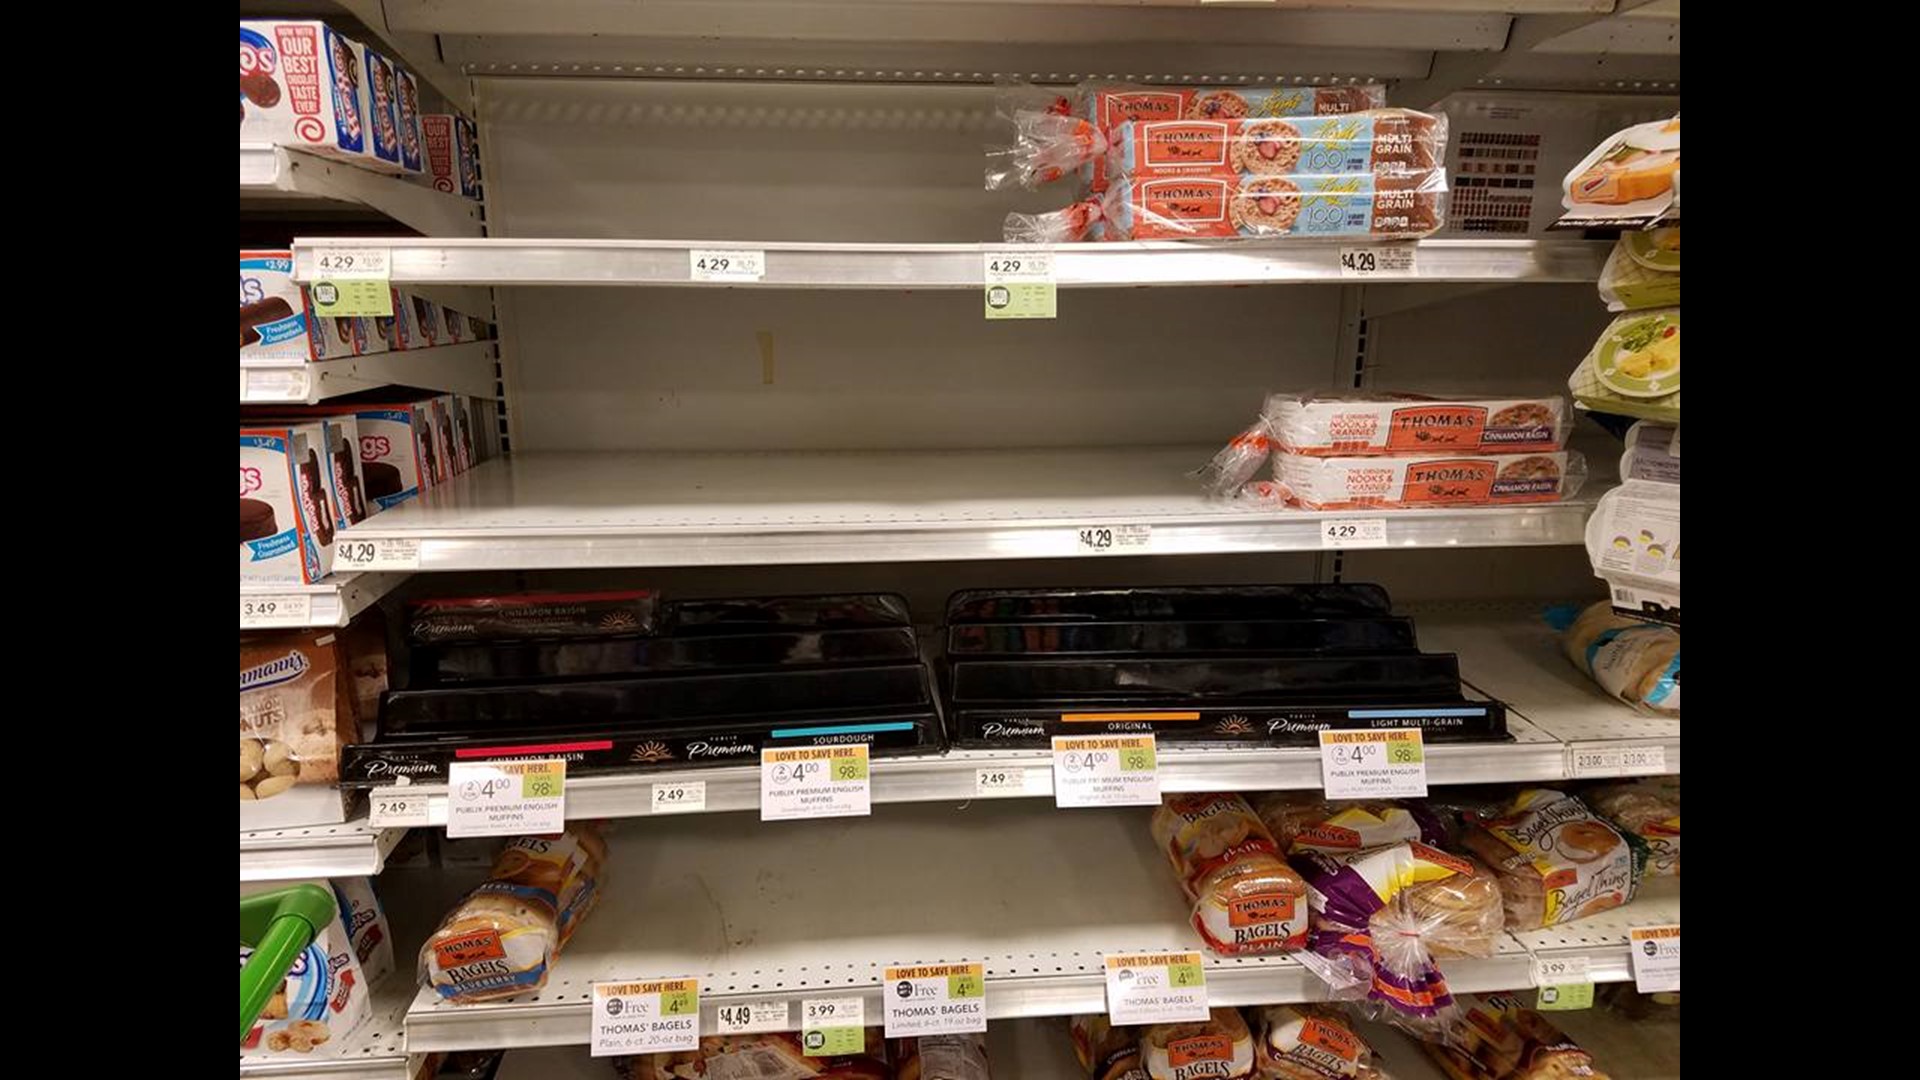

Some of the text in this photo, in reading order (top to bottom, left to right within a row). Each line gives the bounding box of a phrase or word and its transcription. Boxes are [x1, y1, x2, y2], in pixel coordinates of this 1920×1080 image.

[282, 37, 313, 55] OUR
[282, 56, 317, 74] BEST
[290, 86, 318, 100] TASTE
[1116, 102, 1350, 112] THOMAS MULTI
[1155, 131, 1412, 144] THOMAS MULTI
[1375, 144, 1413, 154] GRAIN
[1307, 152, 1344, 169] 100
[1154, 189, 1414, 199] THOMAS MULTI
[1376, 200, 1414, 209] GRAIN
[1307, 207, 1344, 222] 100
[1342, 252, 1376, 271] $4.29
[1330, 421, 1367, 429] NOOKS
[1400, 413, 1475, 430] THOMAS
[1329, 428, 1376, 436] CRANNIES
[1484, 430, 1525, 440] CINNAMON
[1346, 475, 1383, 483] NOOKS
[1415, 469, 1488, 481] THOMAS
[1493, 484, 1530, 493] CINNAMON
[1080, 529, 1112, 548] $4.29
[338, 543, 375, 563] $4.29
[1108, 722, 1153, 731] ORIGINAL
[1266, 718, 1331, 735] Premium
[1371, 718, 1464, 728] LIGHT MULTI-GRAIN
[982, 722, 1046, 739] Premium
[813, 734, 875, 745] SOURDOUGH
[1332, 733, 1353, 743] LOVE
[1355, 733, 1367, 742] TO
[1368, 732, 1387, 741] SAVE
[686, 741, 758, 760] Premium
[1065, 740, 1085, 750] LOVE
[1087, 740, 1098, 749] TO
[1100, 739, 1119, 749] SAVE
[775, 750, 796, 761] LOVE
[799, 750, 810, 760] TO
[811, 748, 832, 759] SAVE
[364, 760, 441, 779] Premium
[503, 764, 525, 775] SAVE
[832, 785, 864, 793] ENGLISH
[488, 814, 524, 822] MUFFINS
[1222, 841, 1262, 862] PLAIN
[1235, 899, 1287, 913] THOMAS
[1234, 922, 1291, 945] BAGELS
[1641, 929, 1659, 939] LOVE
[1239, 941, 1284, 951] PLAIN
[1117, 957, 1137, 967] LOVE
[1138, 956, 1148, 966] TO
[1150, 955, 1168, 965] SAVE
[447, 959, 510, 985] BAGELS
[896, 968, 916, 979] LOVE
[918, 967, 928, 977] TO
[930, 966, 949, 977] SAVE
[607, 985, 627, 996] LOVE
[629, 984, 641, 994] TO
[642, 982, 661, 993] SAVE
[1163, 996, 1194, 1004] BAGELS
[720, 1006, 751, 1026] $4.49
[893, 1003, 980, 1018] THOMAS' BAGELS
[600, 1019, 692, 1035] THOMAS' BAGELS
[1174, 1040, 1225, 1053] THOMAS
[1290, 1043, 1346, 1071] BAGELS
[1175, 1060, 1231, 1080] BAGELS
